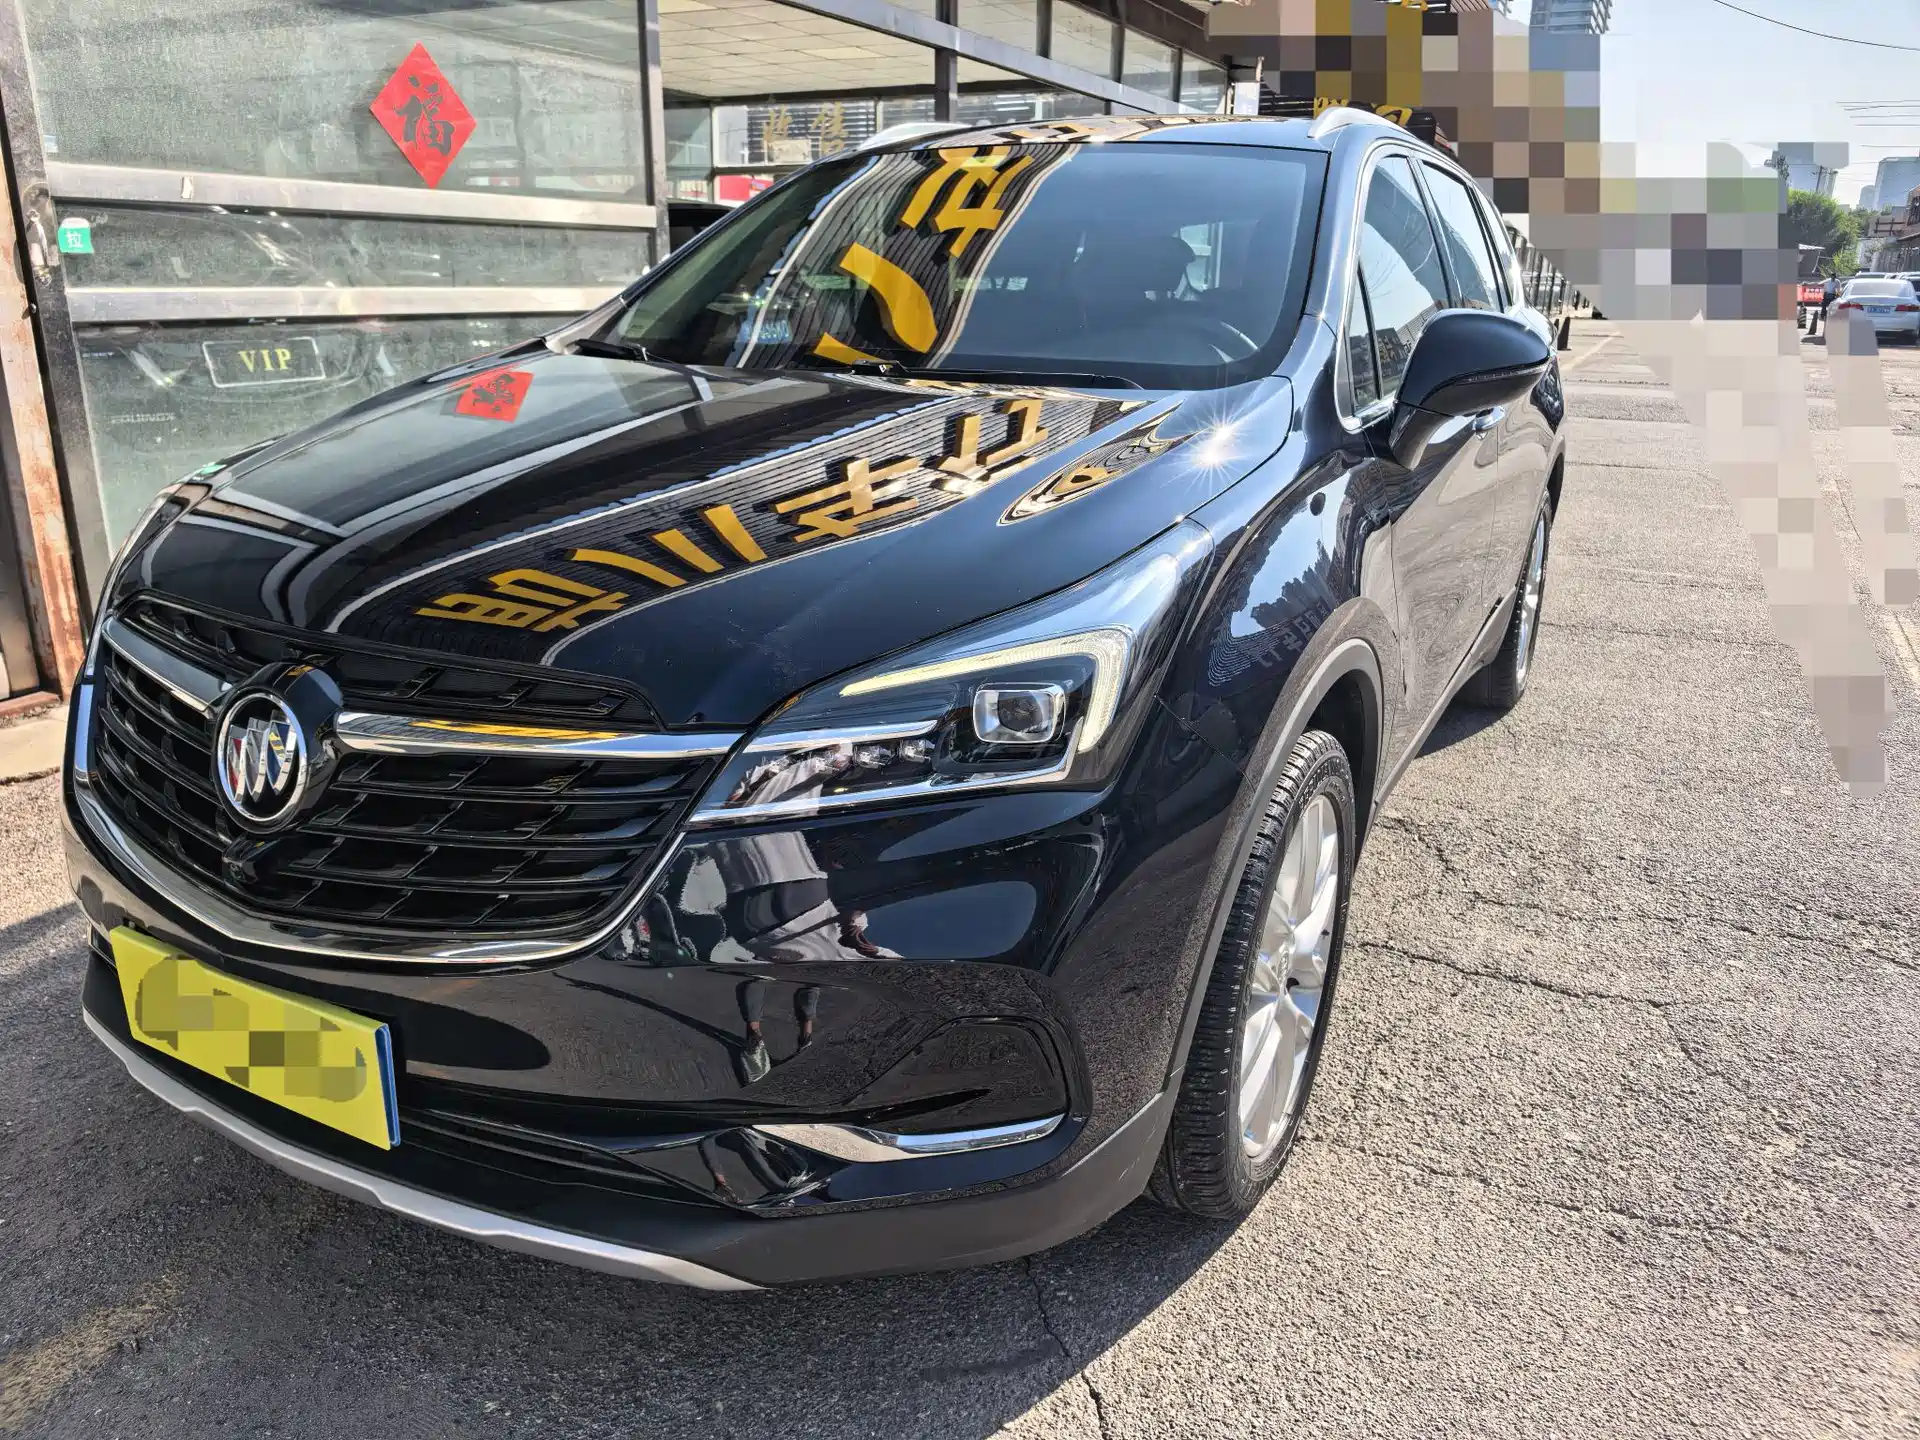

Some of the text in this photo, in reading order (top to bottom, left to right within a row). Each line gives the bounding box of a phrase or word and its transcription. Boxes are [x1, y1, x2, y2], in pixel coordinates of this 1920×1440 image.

[393, 75, 456, 156] 福
[65, 229, 84, 249] 拉
[238, 347, 292, 373] VIP
